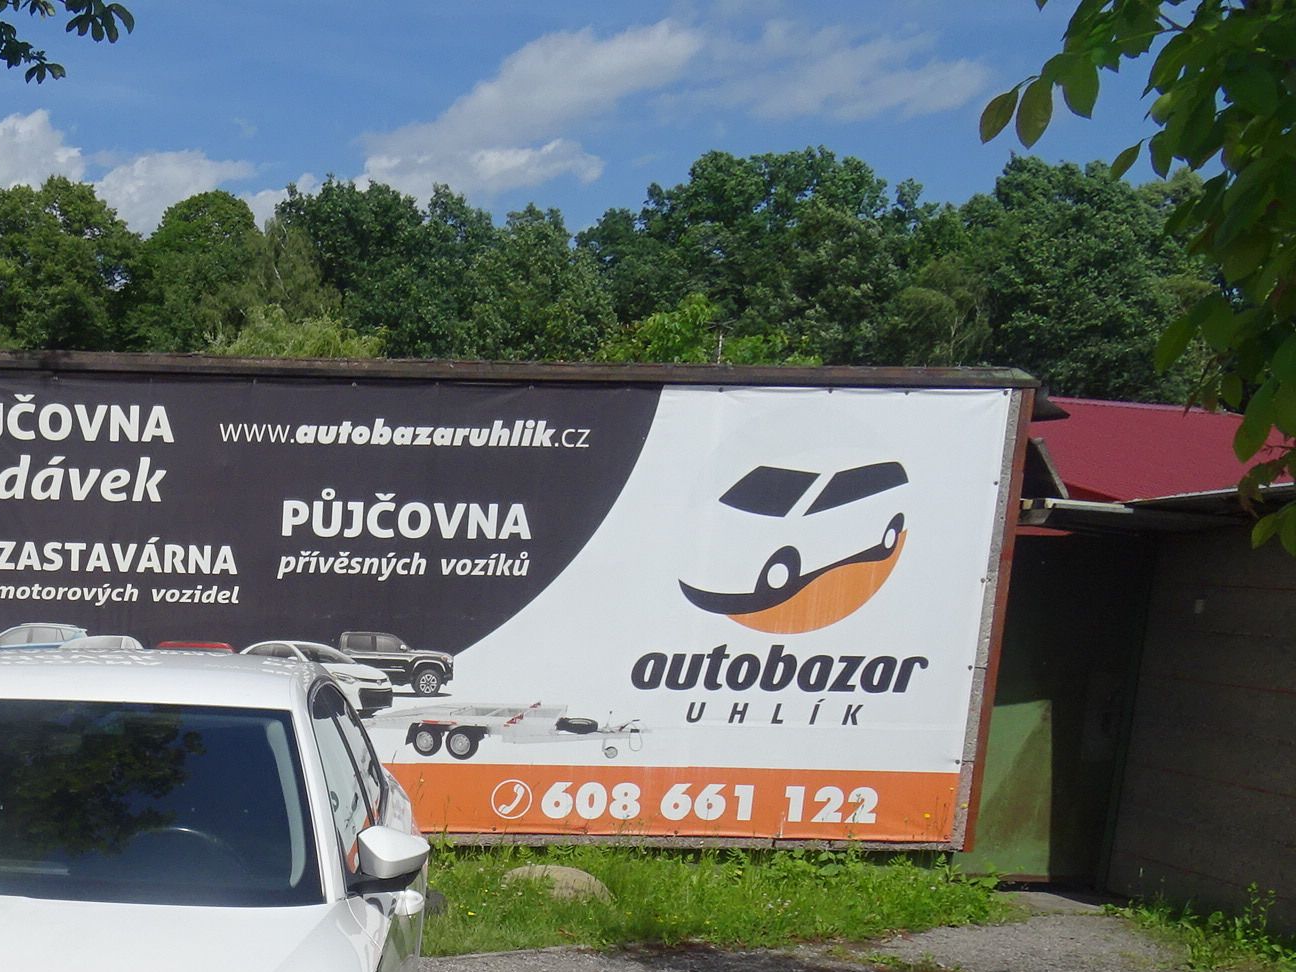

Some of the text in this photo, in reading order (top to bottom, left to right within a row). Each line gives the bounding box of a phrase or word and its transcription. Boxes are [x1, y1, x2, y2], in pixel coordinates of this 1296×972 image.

[219, 418, 590, 449] www.autobazaruhlik.cz
[281, 488, 532, 540] PŮJČOVNA
[278, 550, 531, 580] přívěsných vozíků
[151, 583, 240, 604] vozidel
[631, 644, 929, 694] autobazar
[686, 698, 864, 726] UHLÍK
[541, 781, 878, 823] 608 661 122
